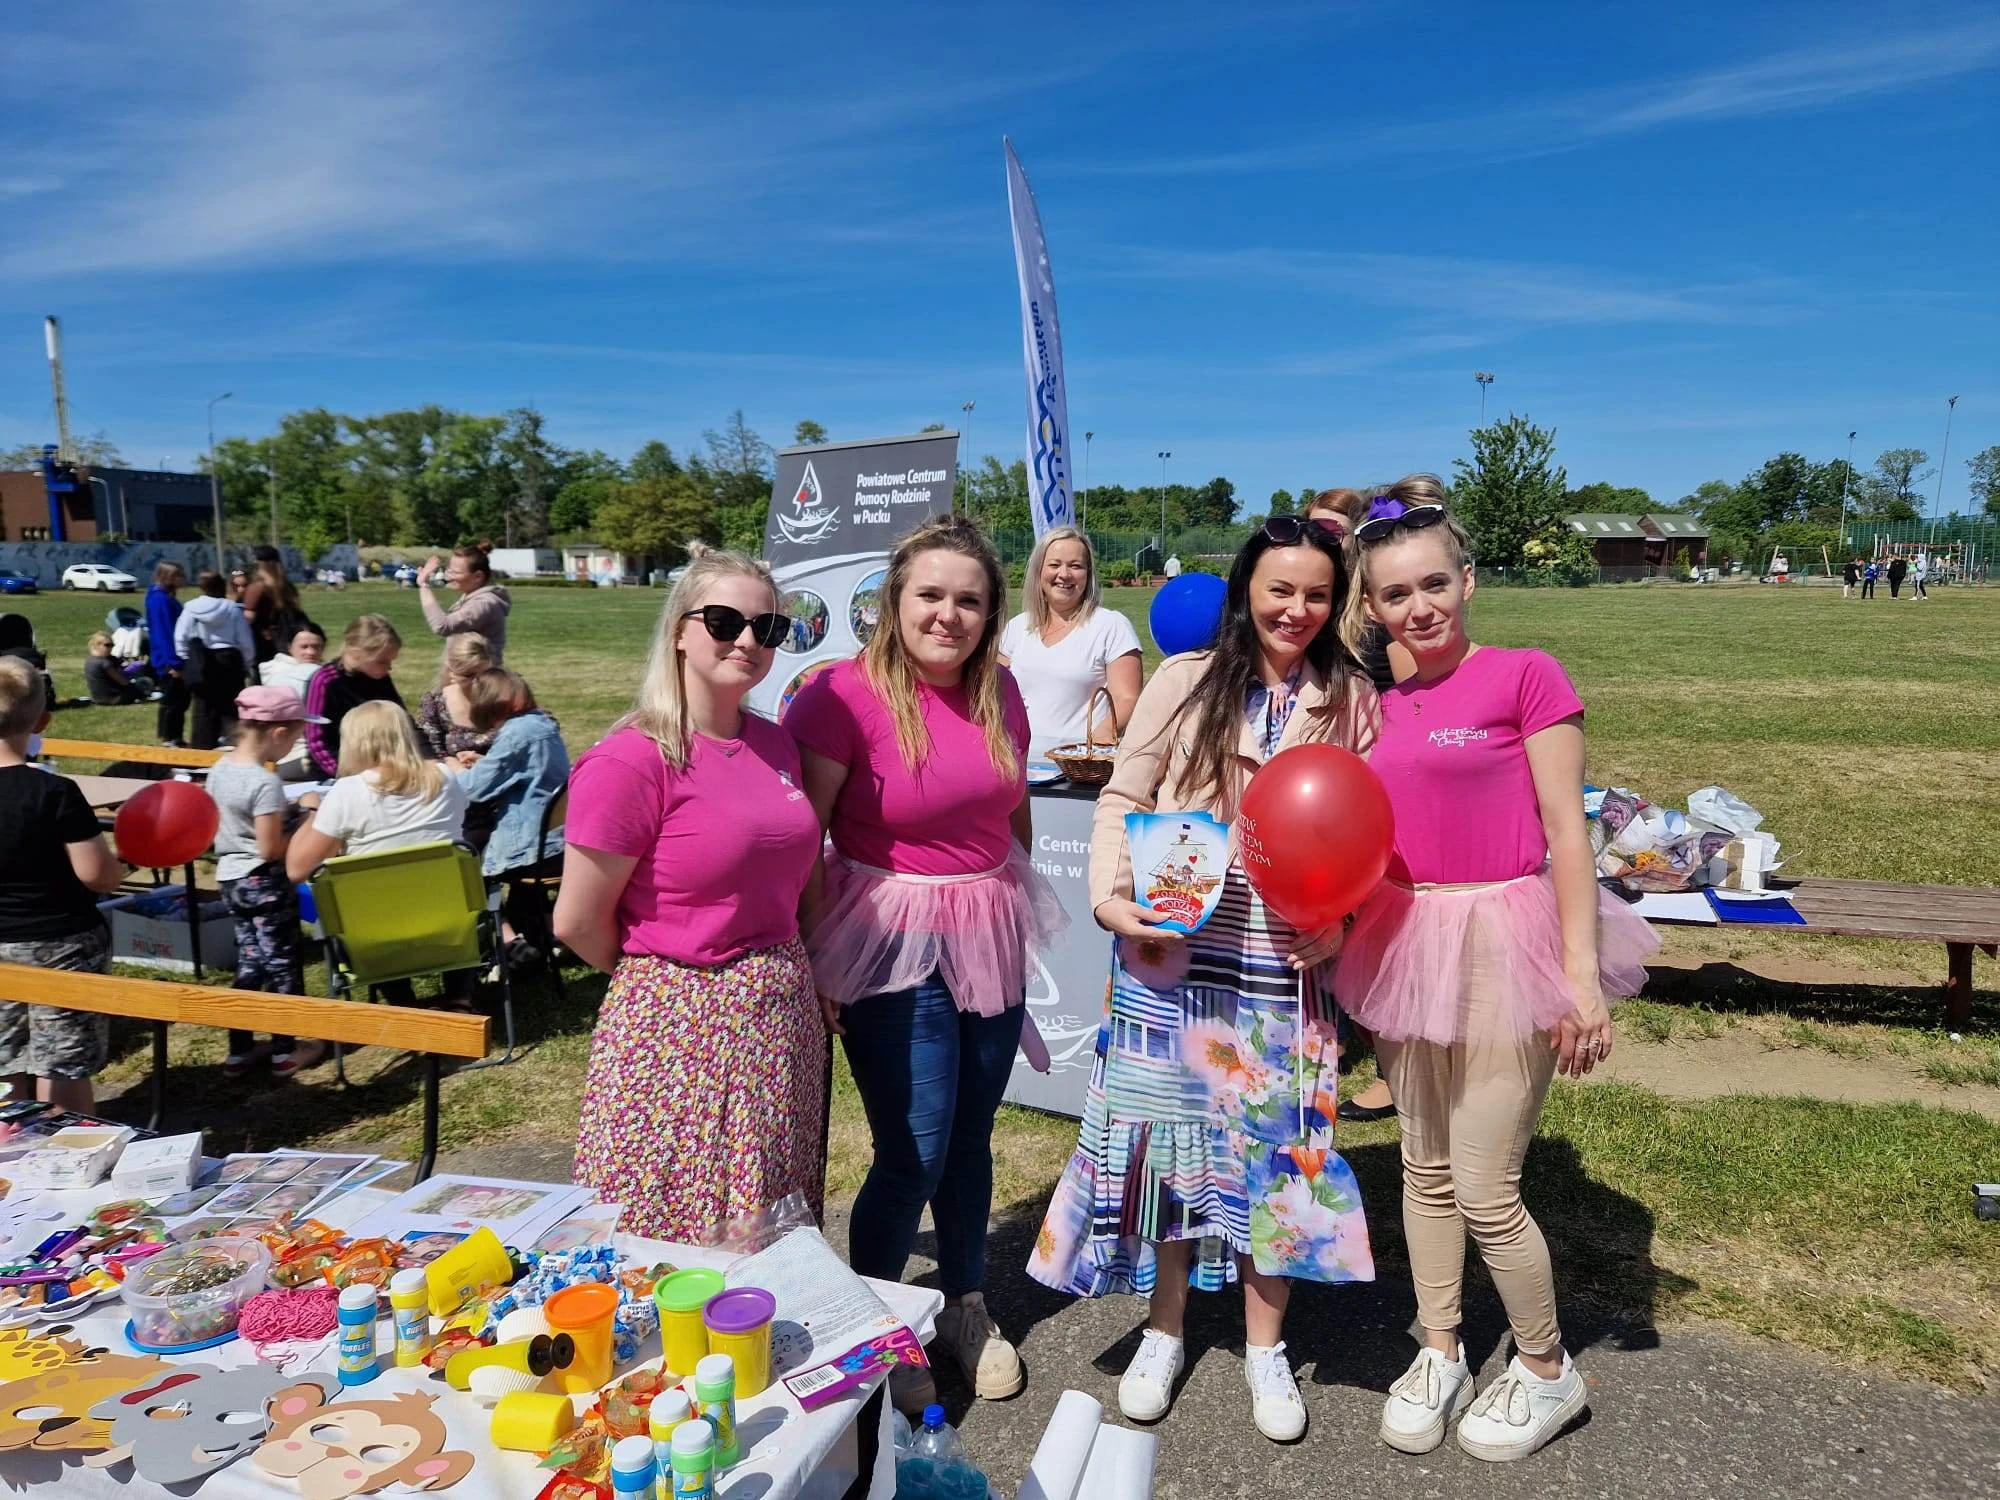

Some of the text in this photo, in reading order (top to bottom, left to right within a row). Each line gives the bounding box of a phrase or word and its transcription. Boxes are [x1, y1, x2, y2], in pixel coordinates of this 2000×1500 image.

[856, 469, 947, 488] Powiatowe Centrum
[854, 487, 931, 508] Pomocy Rodzinie
[853, 509, 891, 524] w Pucku
[1067, 865, 1083, 878] w
